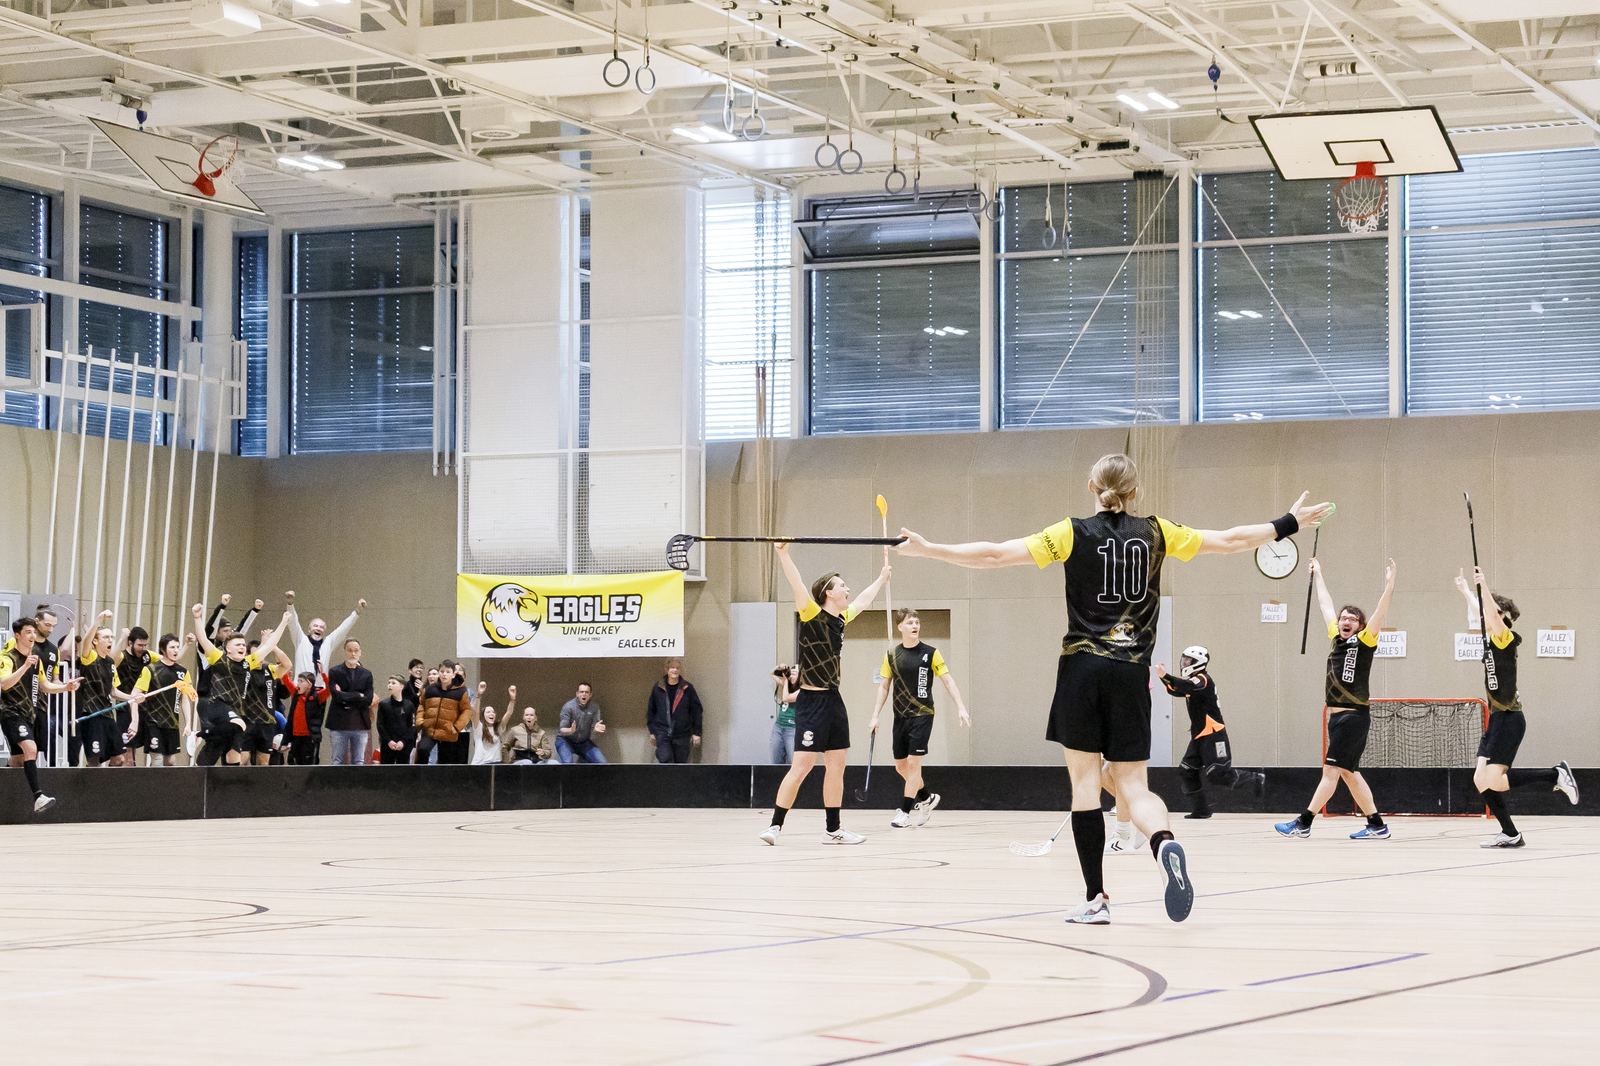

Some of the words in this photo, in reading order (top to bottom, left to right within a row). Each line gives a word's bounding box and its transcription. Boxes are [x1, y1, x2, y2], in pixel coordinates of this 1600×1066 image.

[1097, 538, 1149, 603] 10
[546, 594, 642, 624] EAGLES
[561, 626, 620, 635] UNIHOCKEY
[1379, 634, 1398, 643] ALLEZ
[618, 638, 676, 649] EAGLES.CH
[922, 654, 928, 662] 4
[1342, 646, 1359, 683] EAGLES
[918, 667, 928, 698] EAGLES
